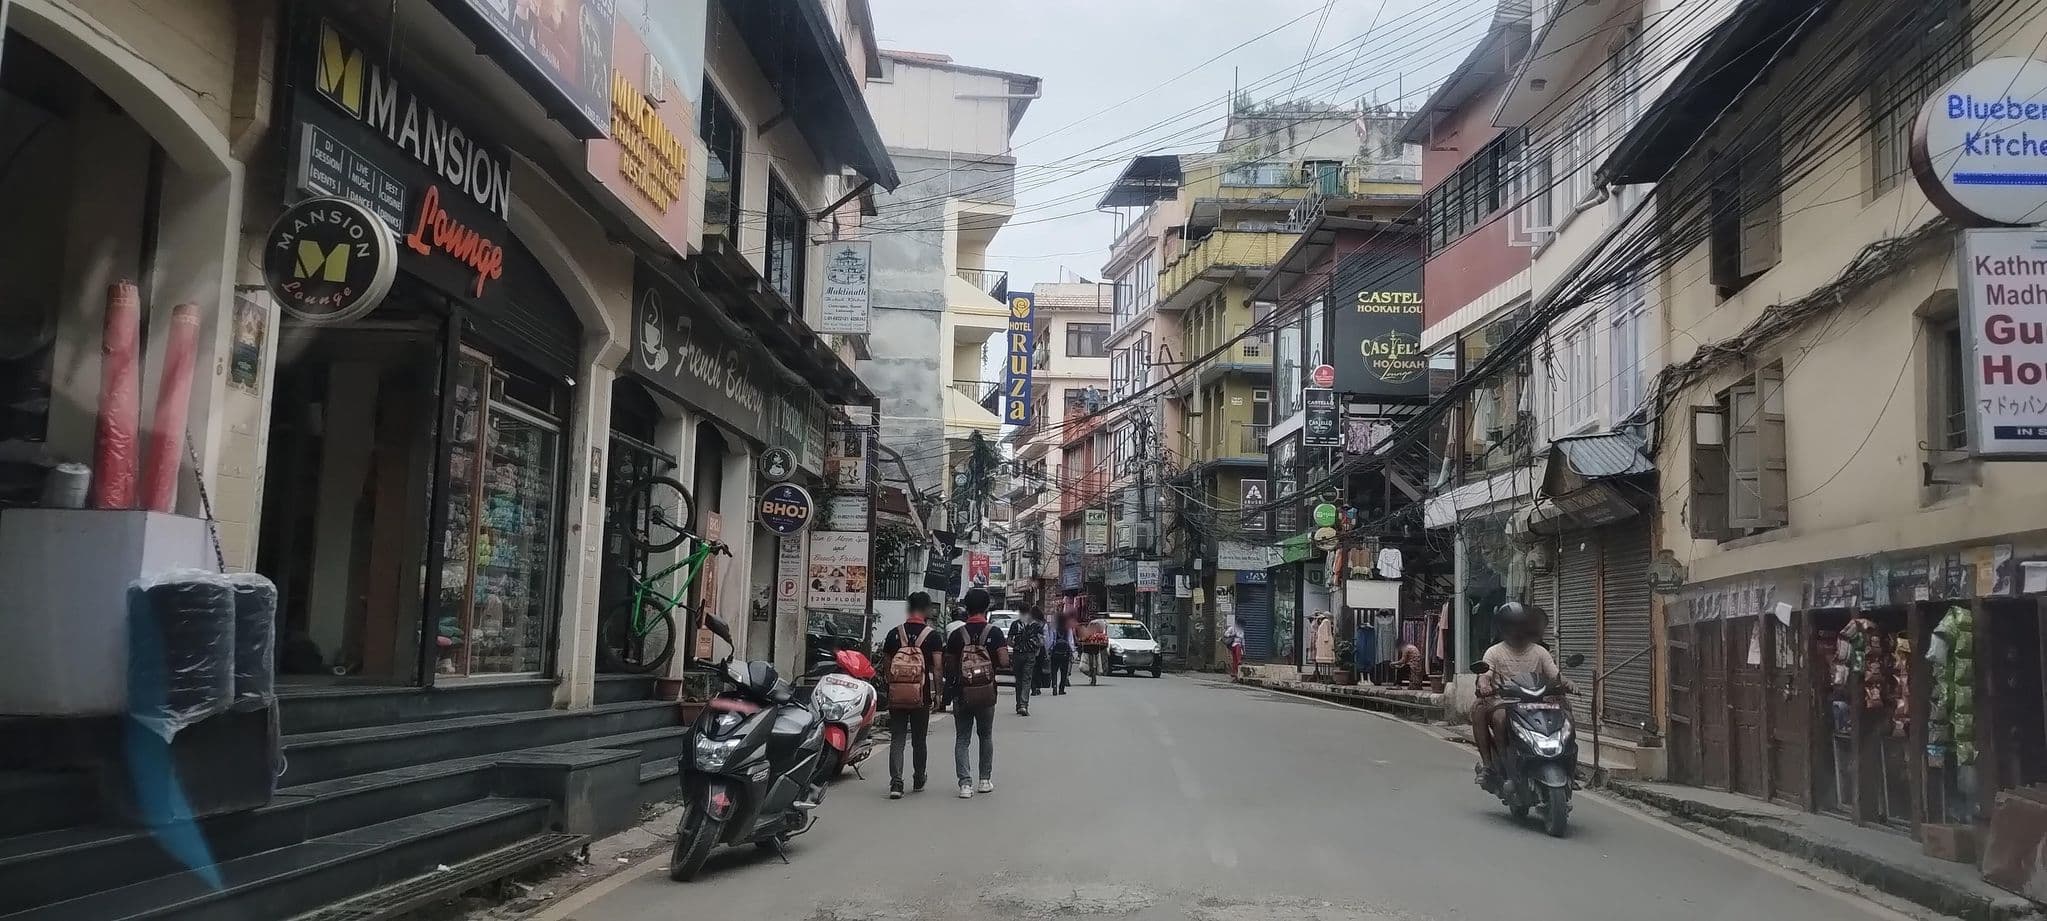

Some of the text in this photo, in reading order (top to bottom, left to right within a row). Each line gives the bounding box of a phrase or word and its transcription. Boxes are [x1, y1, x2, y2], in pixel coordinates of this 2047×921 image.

[613, 68, 688, 179] MUKTINATH
[324, 140, 334, 152] DJ
[367, 63, 512, 222] MANSION
[314, 148, 341, 171] SESSION
[355, 161, 369, 177] LIVE
[312, 168, 337, 190] EVENTS
[351, 172, 371, 192] MUSIC
[385, 181, 399, 196] BEST
[622, 152, 671, 215] RESTAURANT
[277, 208, 370, 261] MANSION
[407, 184, 504, 300] Lounge
[280, 279, 353, 308] Lounge
[1986, 284, 2047, 305] Madh
[1357, 304, 1401, 313] HOOKAH
[1010, 321, 1032, 332] HOTEL
[675, 315, 723, 390] French
[1373, 360, 1425, 369] HOOKAH
[1983, 355, 2047, 385] Ho
[725, 350, 764, 430] Bakery
[2017, 427, 2032, 435] IN
[762, 501, 807, 519] BHOJ
[785, 581, 795, 594] P
